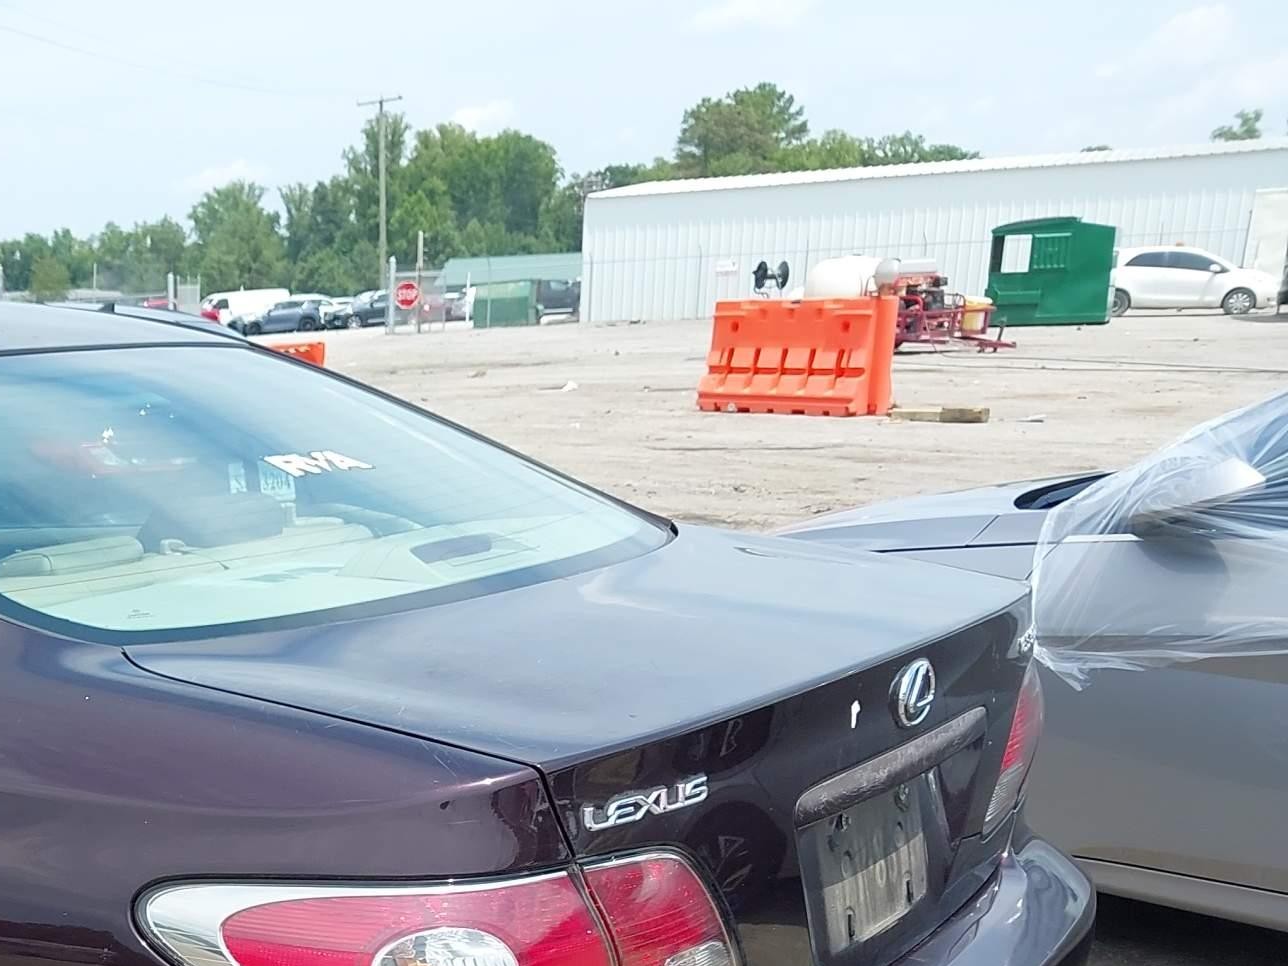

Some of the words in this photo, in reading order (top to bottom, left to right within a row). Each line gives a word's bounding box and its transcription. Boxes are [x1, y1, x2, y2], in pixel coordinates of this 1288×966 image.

[397, 288, 418, 301] STOP
[263, 450, 375, 478] RVA
[582, 775, 709, 832] LEXUS
